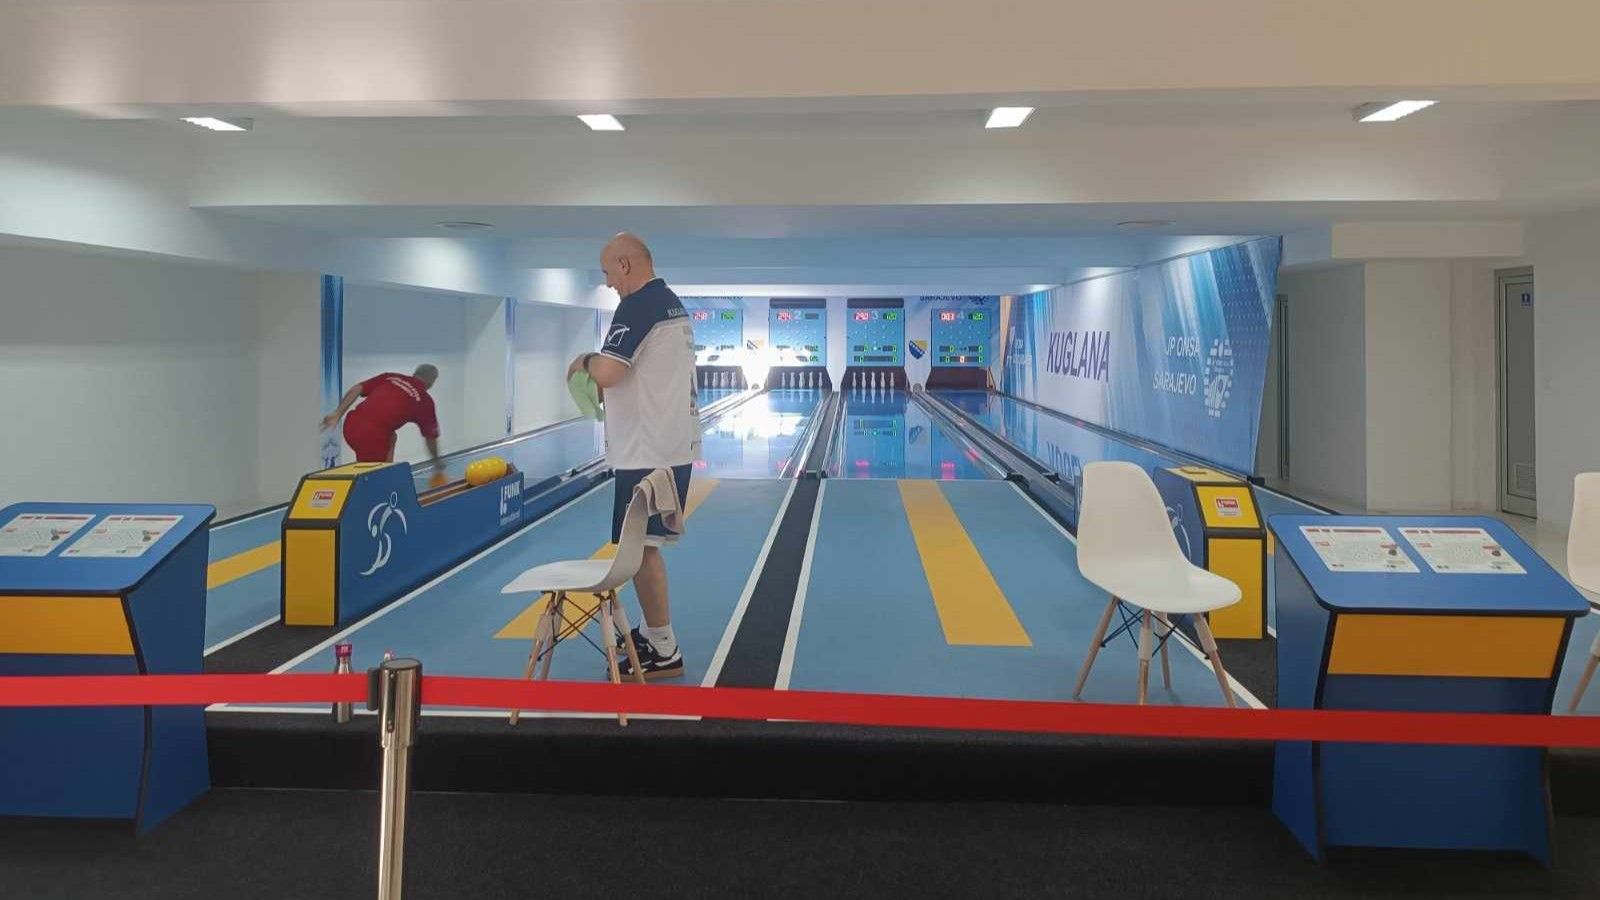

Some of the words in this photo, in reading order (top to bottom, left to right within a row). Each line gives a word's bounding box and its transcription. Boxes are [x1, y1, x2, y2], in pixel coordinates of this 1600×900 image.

[872, 311, 879, 320] 3
[1047, 331, 1110, 382] KUGLANA
[1165, 336, 1176, 356] JP
[1177, 336, 1200, 358] ONSA
[1153, 373, 1197, 395] SARAJEVO
